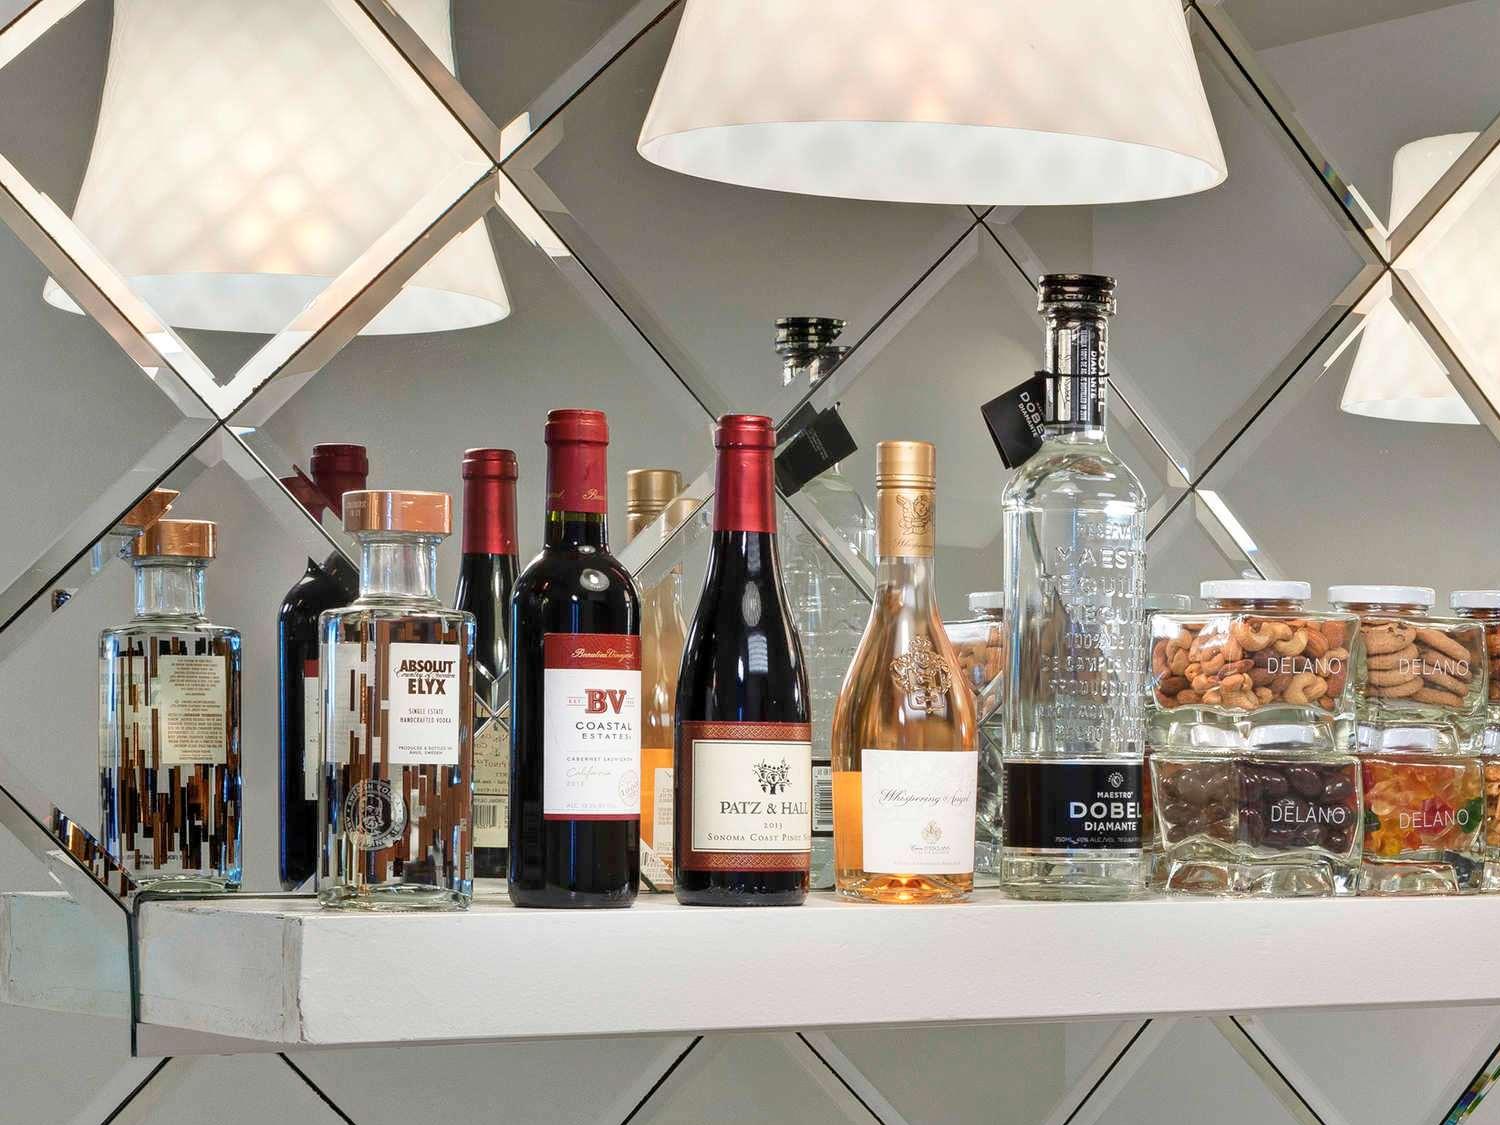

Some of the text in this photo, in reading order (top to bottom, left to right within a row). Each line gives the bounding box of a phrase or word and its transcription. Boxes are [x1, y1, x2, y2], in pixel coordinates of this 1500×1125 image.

[400, 659, 454, 673] ABSOLUT
[1267, 657, 1342, 675] DELANO
[1399, 658, 1469, 677] DELANO
[408, 678, 447, 695] ELYX
[584, 688, 627, 714] BV
[575, 721, 632, 732] COASTAL
[766, 803, 777, 815] &
[781, 801, 809, 815] HALL
[1069, 801, 1142, 819] DOBEL
[1271, 806, 1346, 824] DELANO
[1084, 821, 1137, 831] DIAMANTE
[1399, 808, 1469, 829] DELANO
